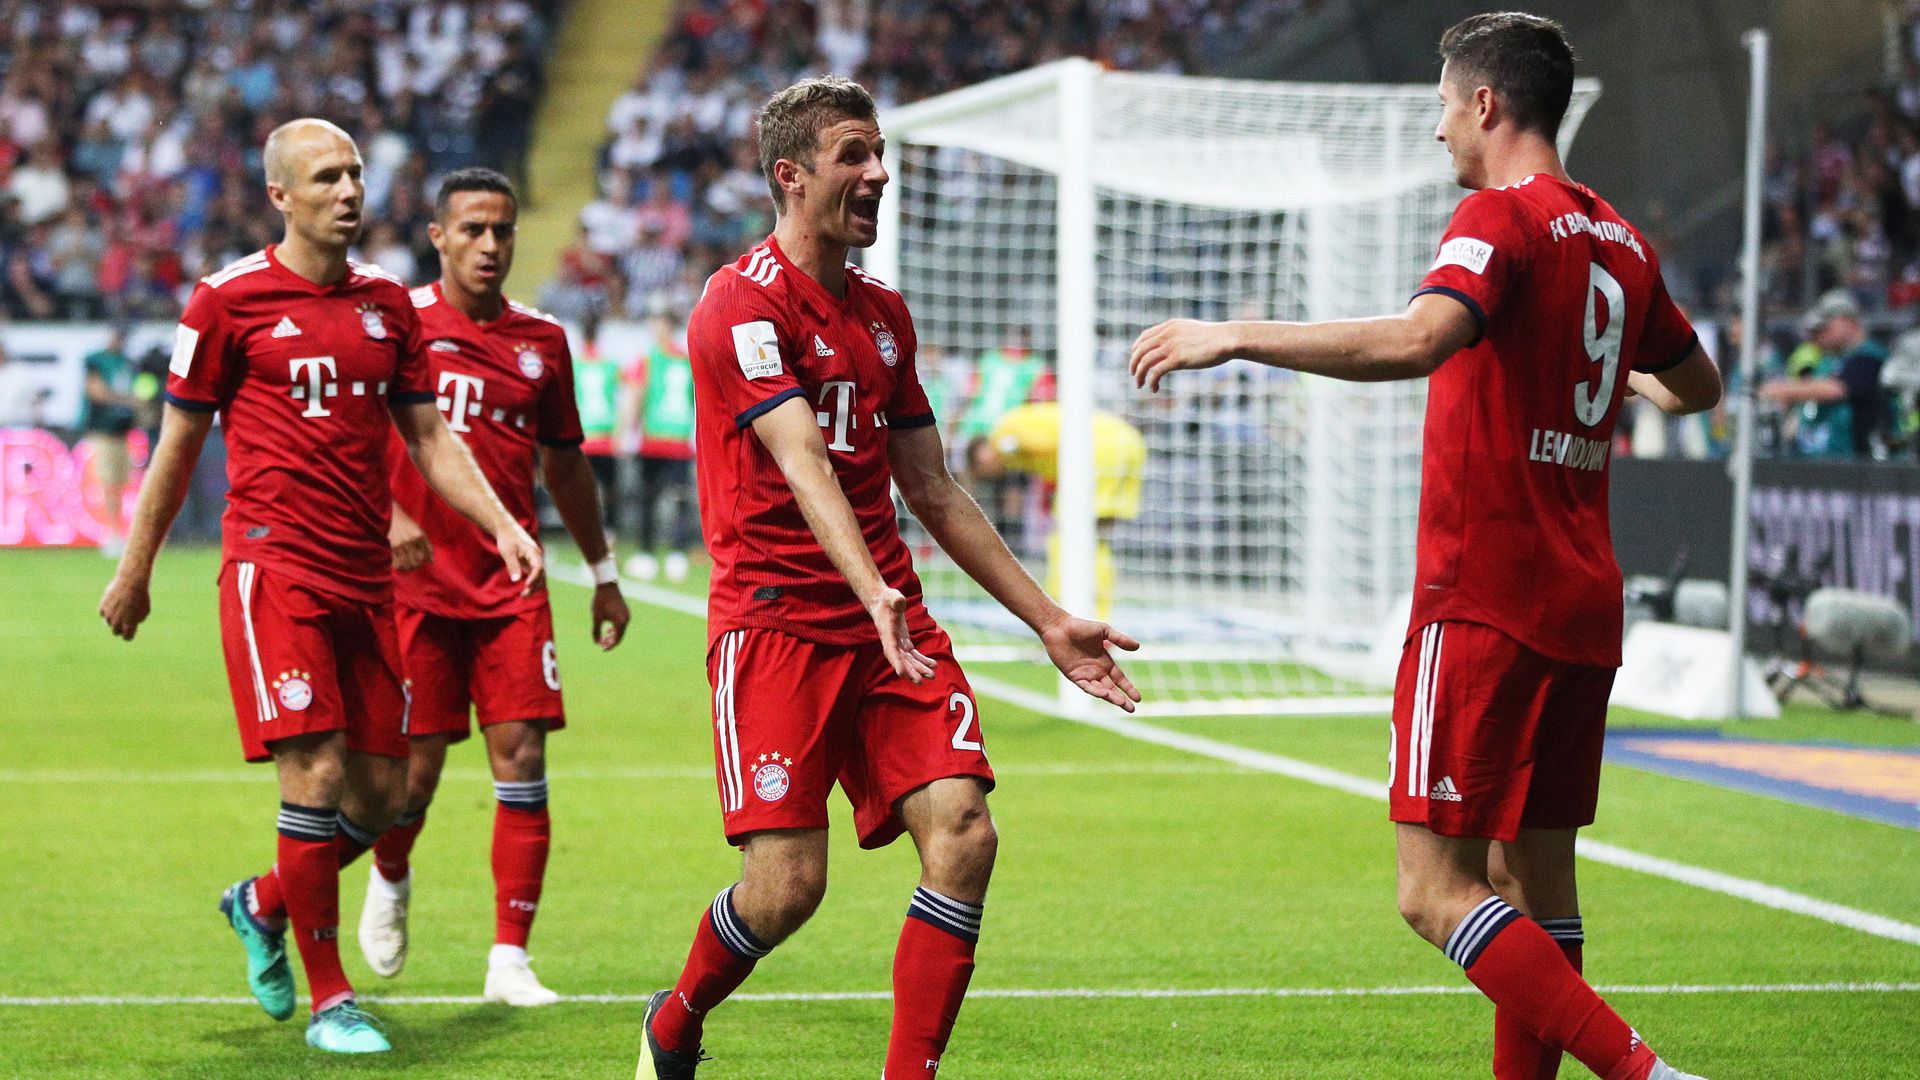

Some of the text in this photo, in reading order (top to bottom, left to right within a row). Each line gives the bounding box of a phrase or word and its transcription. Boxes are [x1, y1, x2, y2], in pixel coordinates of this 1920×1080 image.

[1574, 261, 1626, 428] 9
[542, 640, 561, 691] 6
[762, 765, 786, 780] BAYERN
[1430, 791, 1463, 803] adidas
